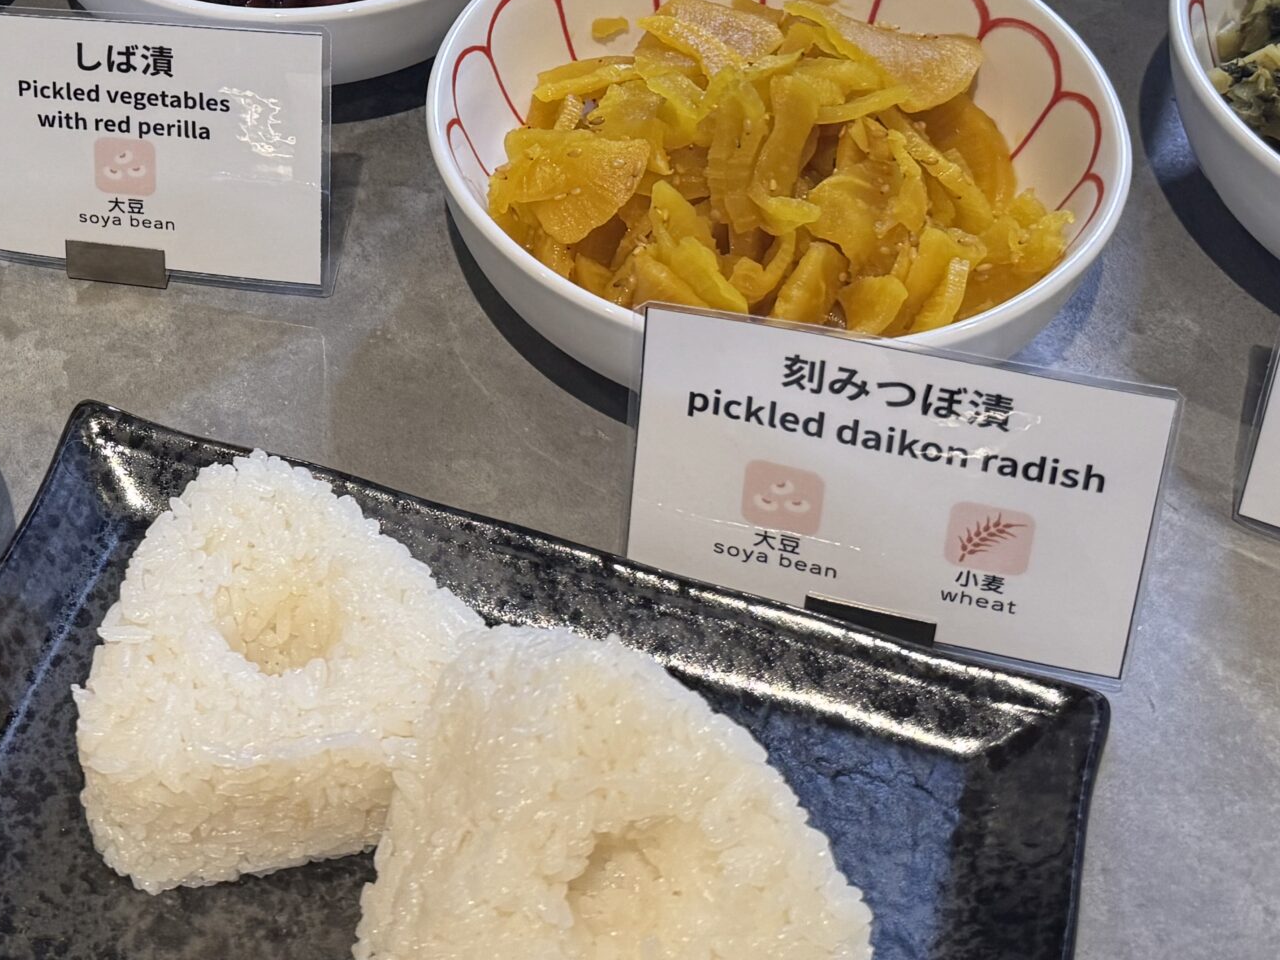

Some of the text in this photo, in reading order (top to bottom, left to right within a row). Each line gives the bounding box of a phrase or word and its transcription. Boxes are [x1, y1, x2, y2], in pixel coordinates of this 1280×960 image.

[76, 41, 174, 78] しば漬
[18, 80, 231, 113] Pickled vegetables
[37, 111, 212, 140] with red perilla
[107, 198, 145, 215] 大豆
[79, 212, 176, 231] soya bean
[781, 353, 1016, 433] 刻みつぼ漬
[686, 388, 1108, 494] pickled daikon radish
[753, 530, 801, 555] 大豆
[713, 540, 838, 580] soya bean
[955, 569, 1006, 595] 小麦
[940, 587, 1018, 615] wheat
